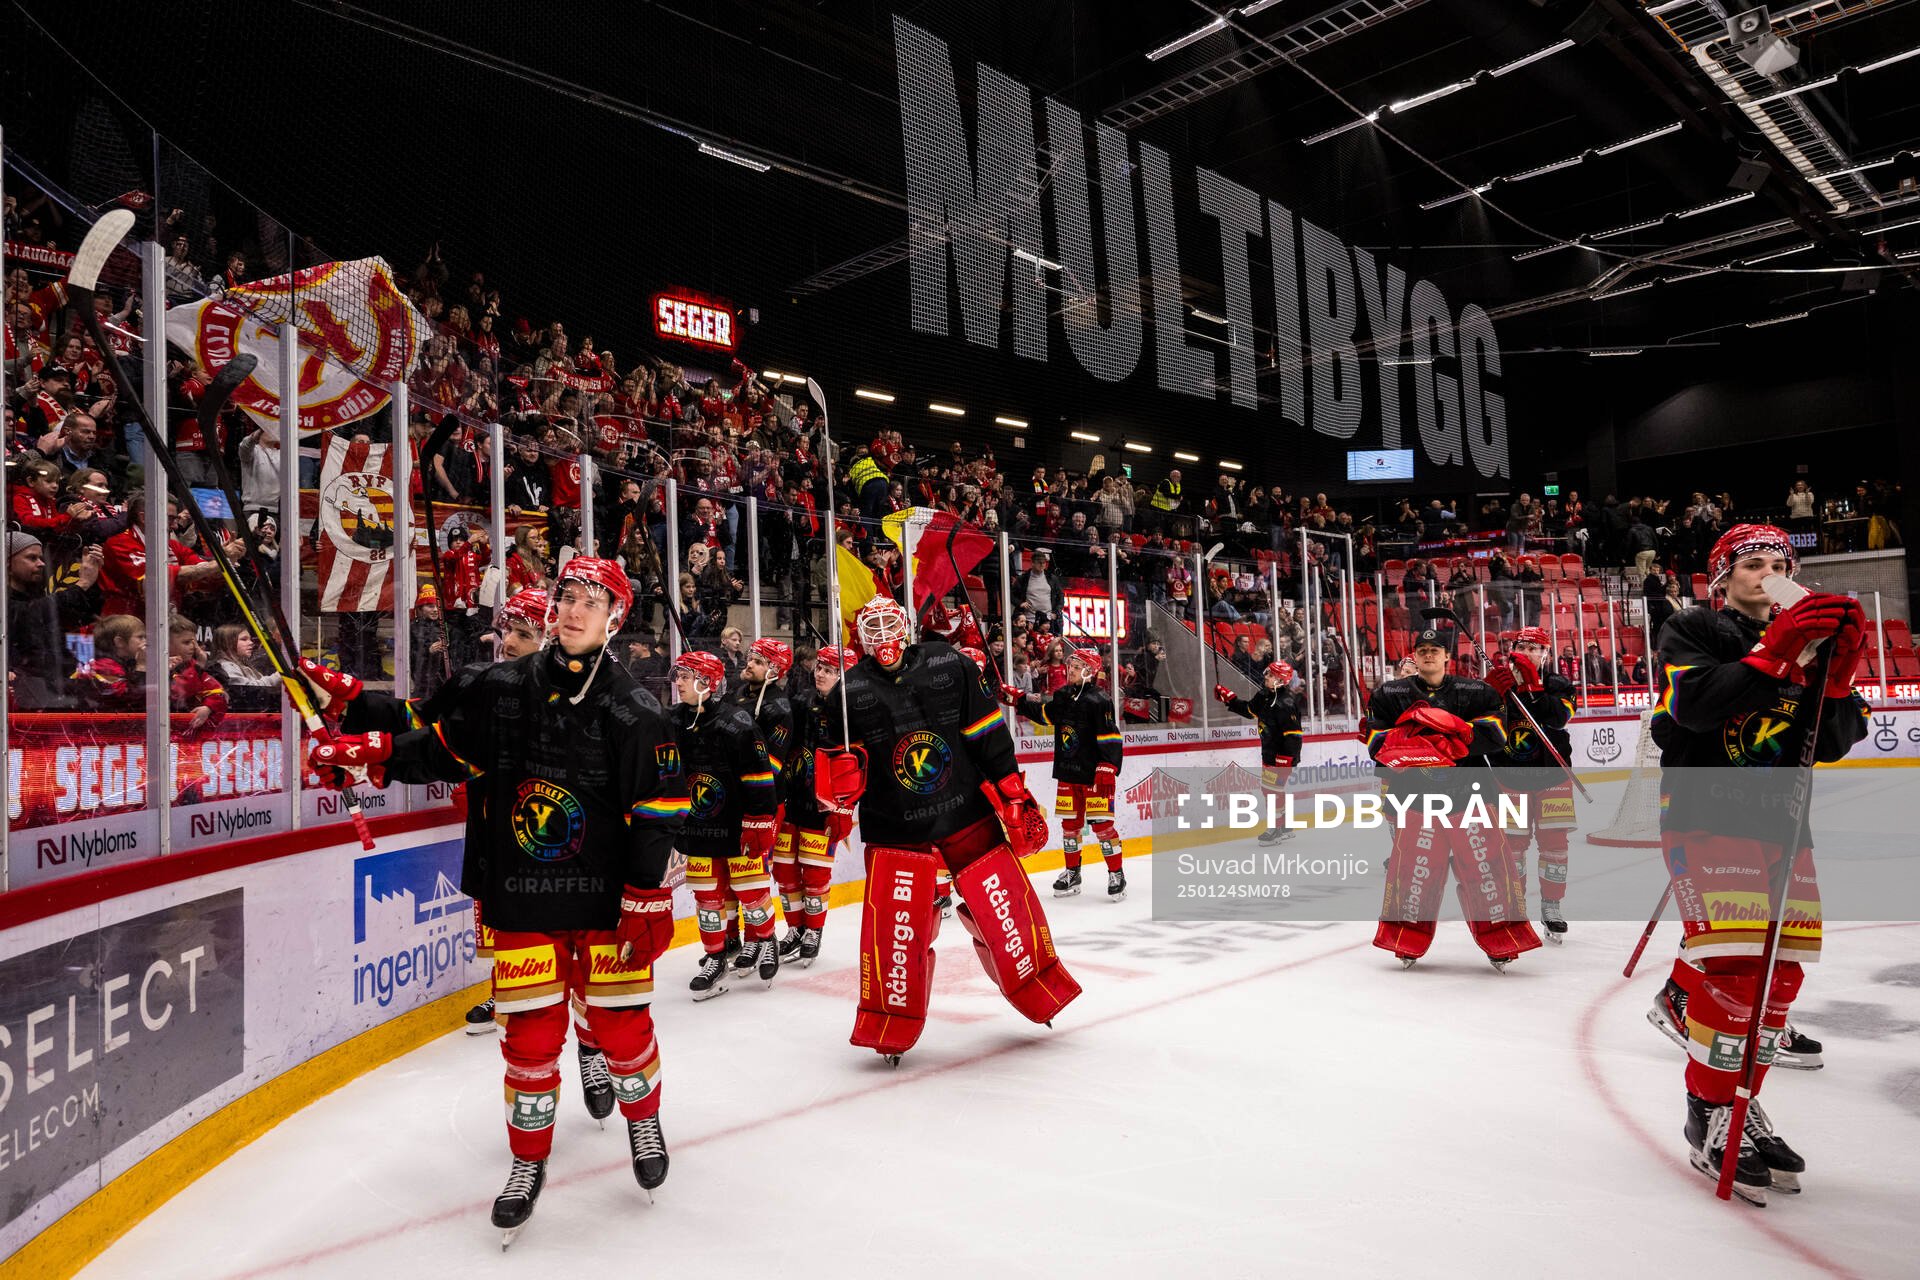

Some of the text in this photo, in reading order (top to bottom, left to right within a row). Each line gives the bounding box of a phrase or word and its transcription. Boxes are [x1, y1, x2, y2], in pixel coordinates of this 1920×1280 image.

[892, 13, 1510, 480] MULTIBYGG
[658, 297, 732, 346] SEGER
[348, 474, 387, 488] RYF
[369, 550, 386, 561] 22
[926, 652, 959, 668] Molin
[909, 733, 935, 744] HOCKEY
[1033, 737, 1055, 749] Nyblo
[1135, 734, 1158, 743] Nybloms
[1177, 731, 1199, 741] Nybloms
[1592, 728, 1615, 746] AGB
[1751, 717, 1791, 756] K
[1592, 746, 1615, 756] SERVICE
[910, 748, 937, 777] K
[904, 796, 965, 821] GIRAFFEN
[1137, 802, 1162, 821] TAK
[217, 808, 272, 838] Nybloms
[71, 828, 137, 867] Nybloms
[800, 834, 826, 851] Molins
[730, 860, 762, 873] Molins
[1715, 866, 1761, 876] BAUER
[504, 876, 605, 895] GIRAFFEN
[700, 909, 720, 923] TG
[1684, 878, 1706, 932] KALMAR
[1711, 899, 1771, 922] Molin
[982, 873, 1034, 980] Råbergs Bil
[886, 871, 914, 1007] Bil Råbergs
[1040, 926, 1055, 958] BAUER
[354, 925, 477, 1007] ingenjörs
[496, 957, 553, 982] Molins
[862, 952, 871, 1000] BAUER
[0, 945, 205, 1113] SELECT
[518, 1094, 555, 1115] TG
